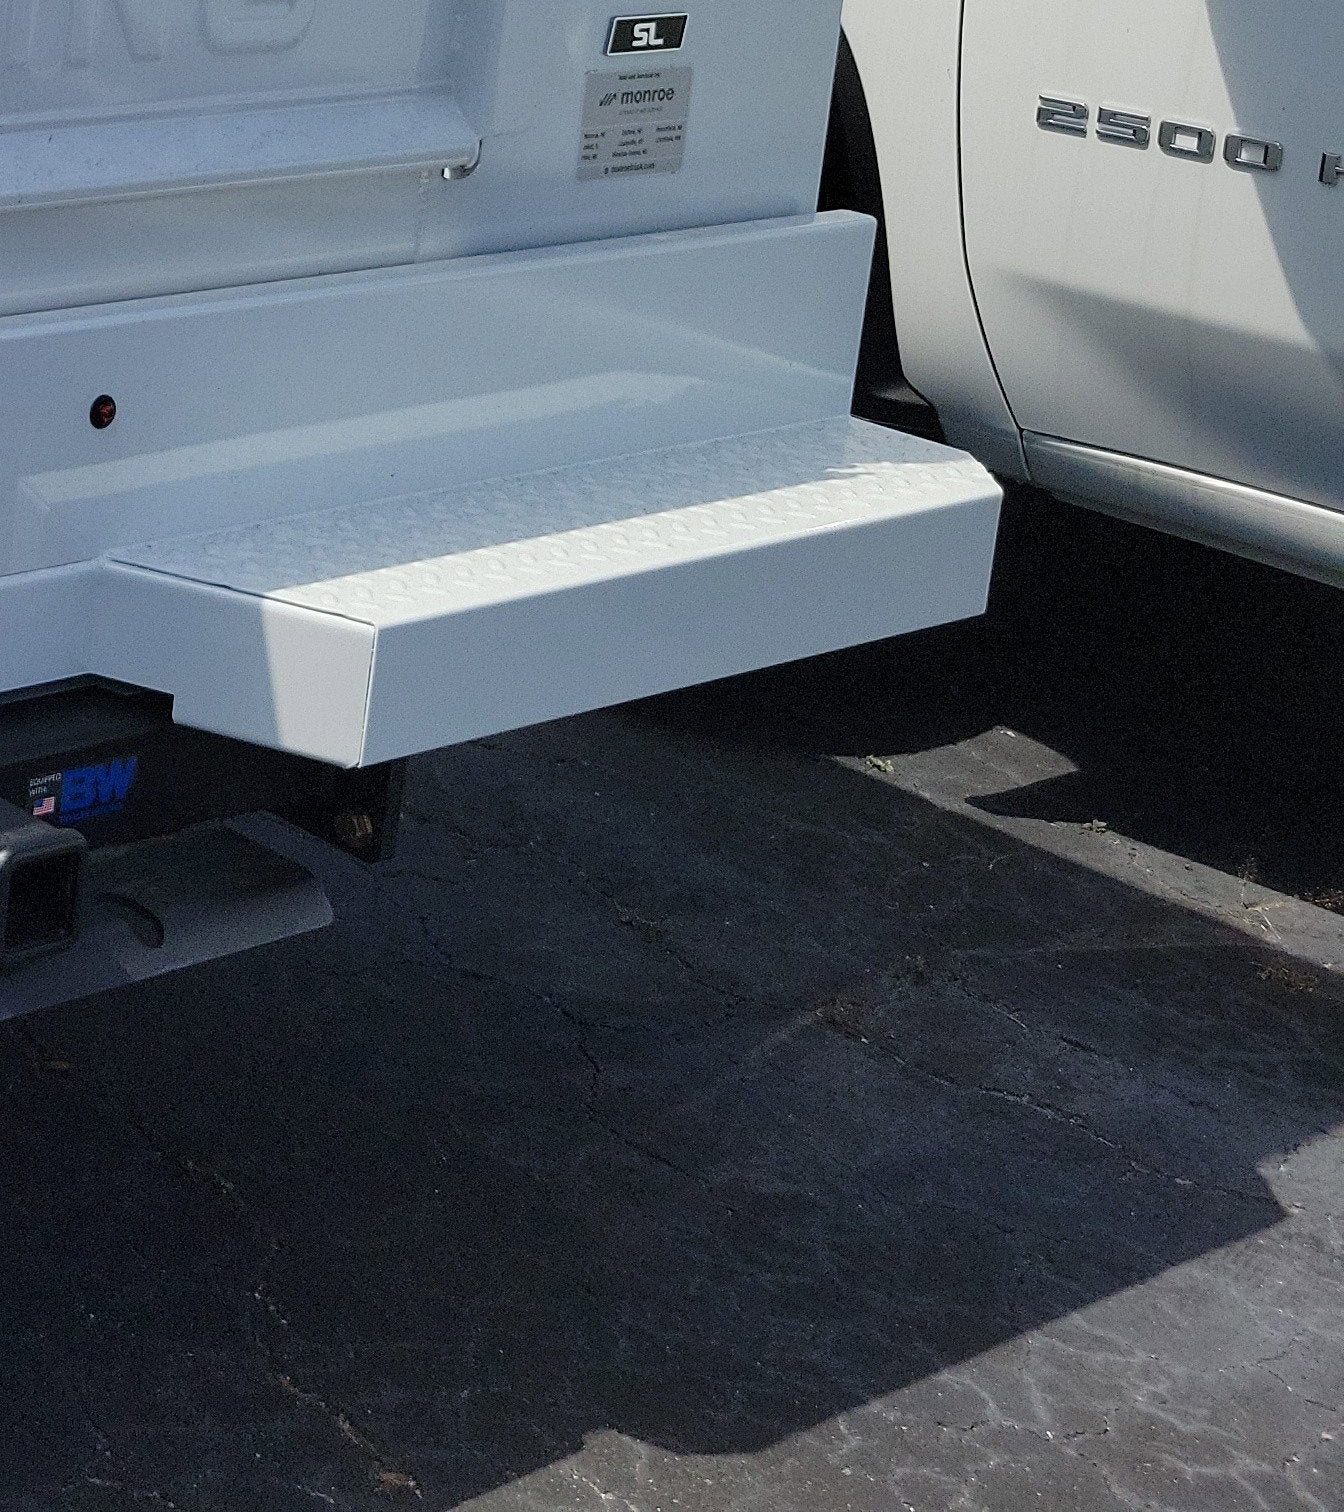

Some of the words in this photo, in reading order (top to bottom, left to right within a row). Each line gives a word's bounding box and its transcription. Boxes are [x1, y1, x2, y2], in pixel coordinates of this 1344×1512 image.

[631, 21, 664, 47] SL
[620, 87, 675, 105] monroe
[1036, 94, 1284, 172] 2500
